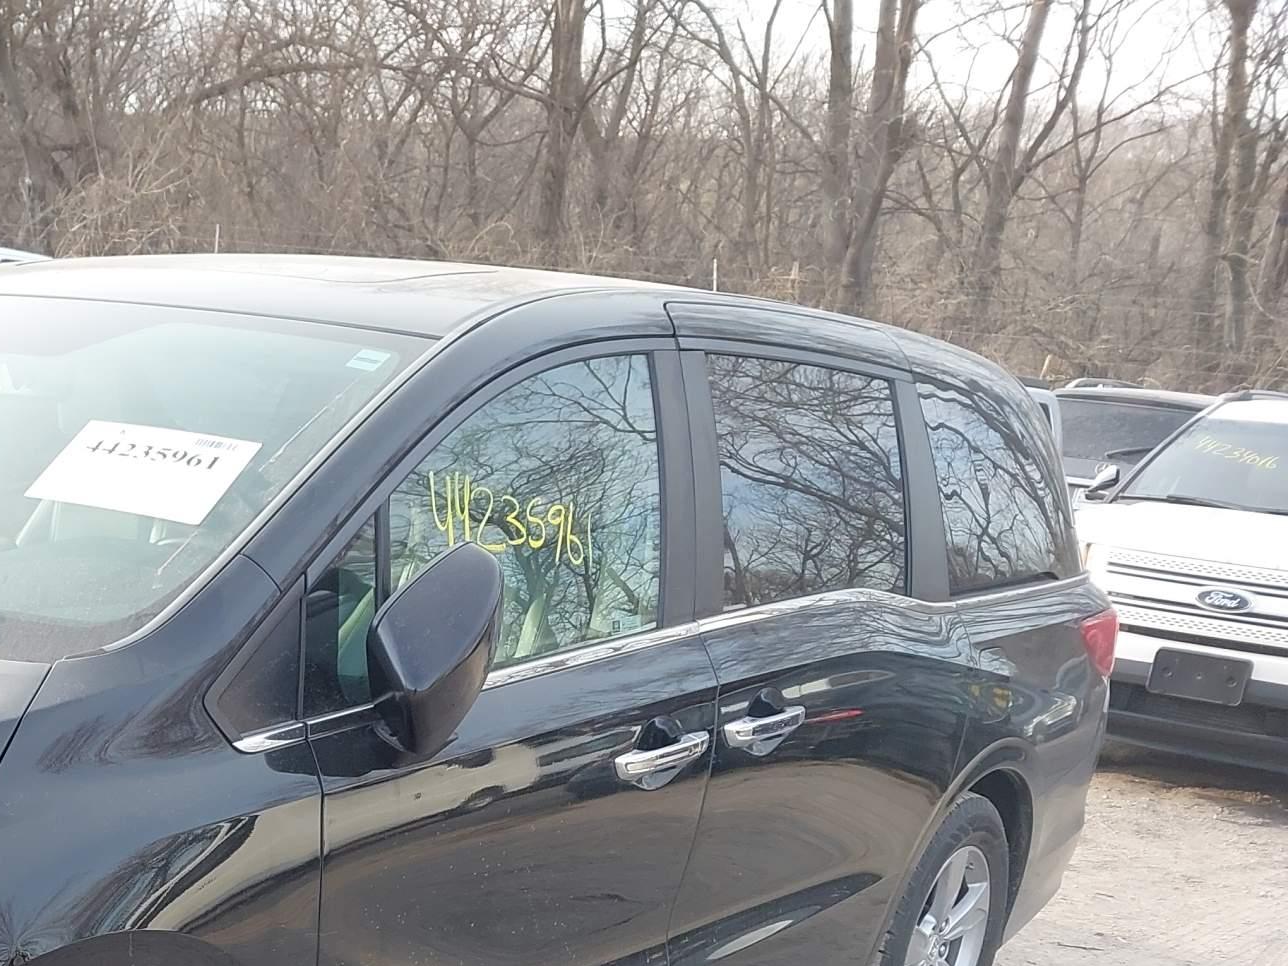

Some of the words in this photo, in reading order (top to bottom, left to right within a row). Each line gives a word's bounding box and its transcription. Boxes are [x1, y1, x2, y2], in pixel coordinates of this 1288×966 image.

[86, 438, 220, 470] 44235961
[429, 471, 594, 575] 44235961
[1204, 591, 1241, 608] Ford
